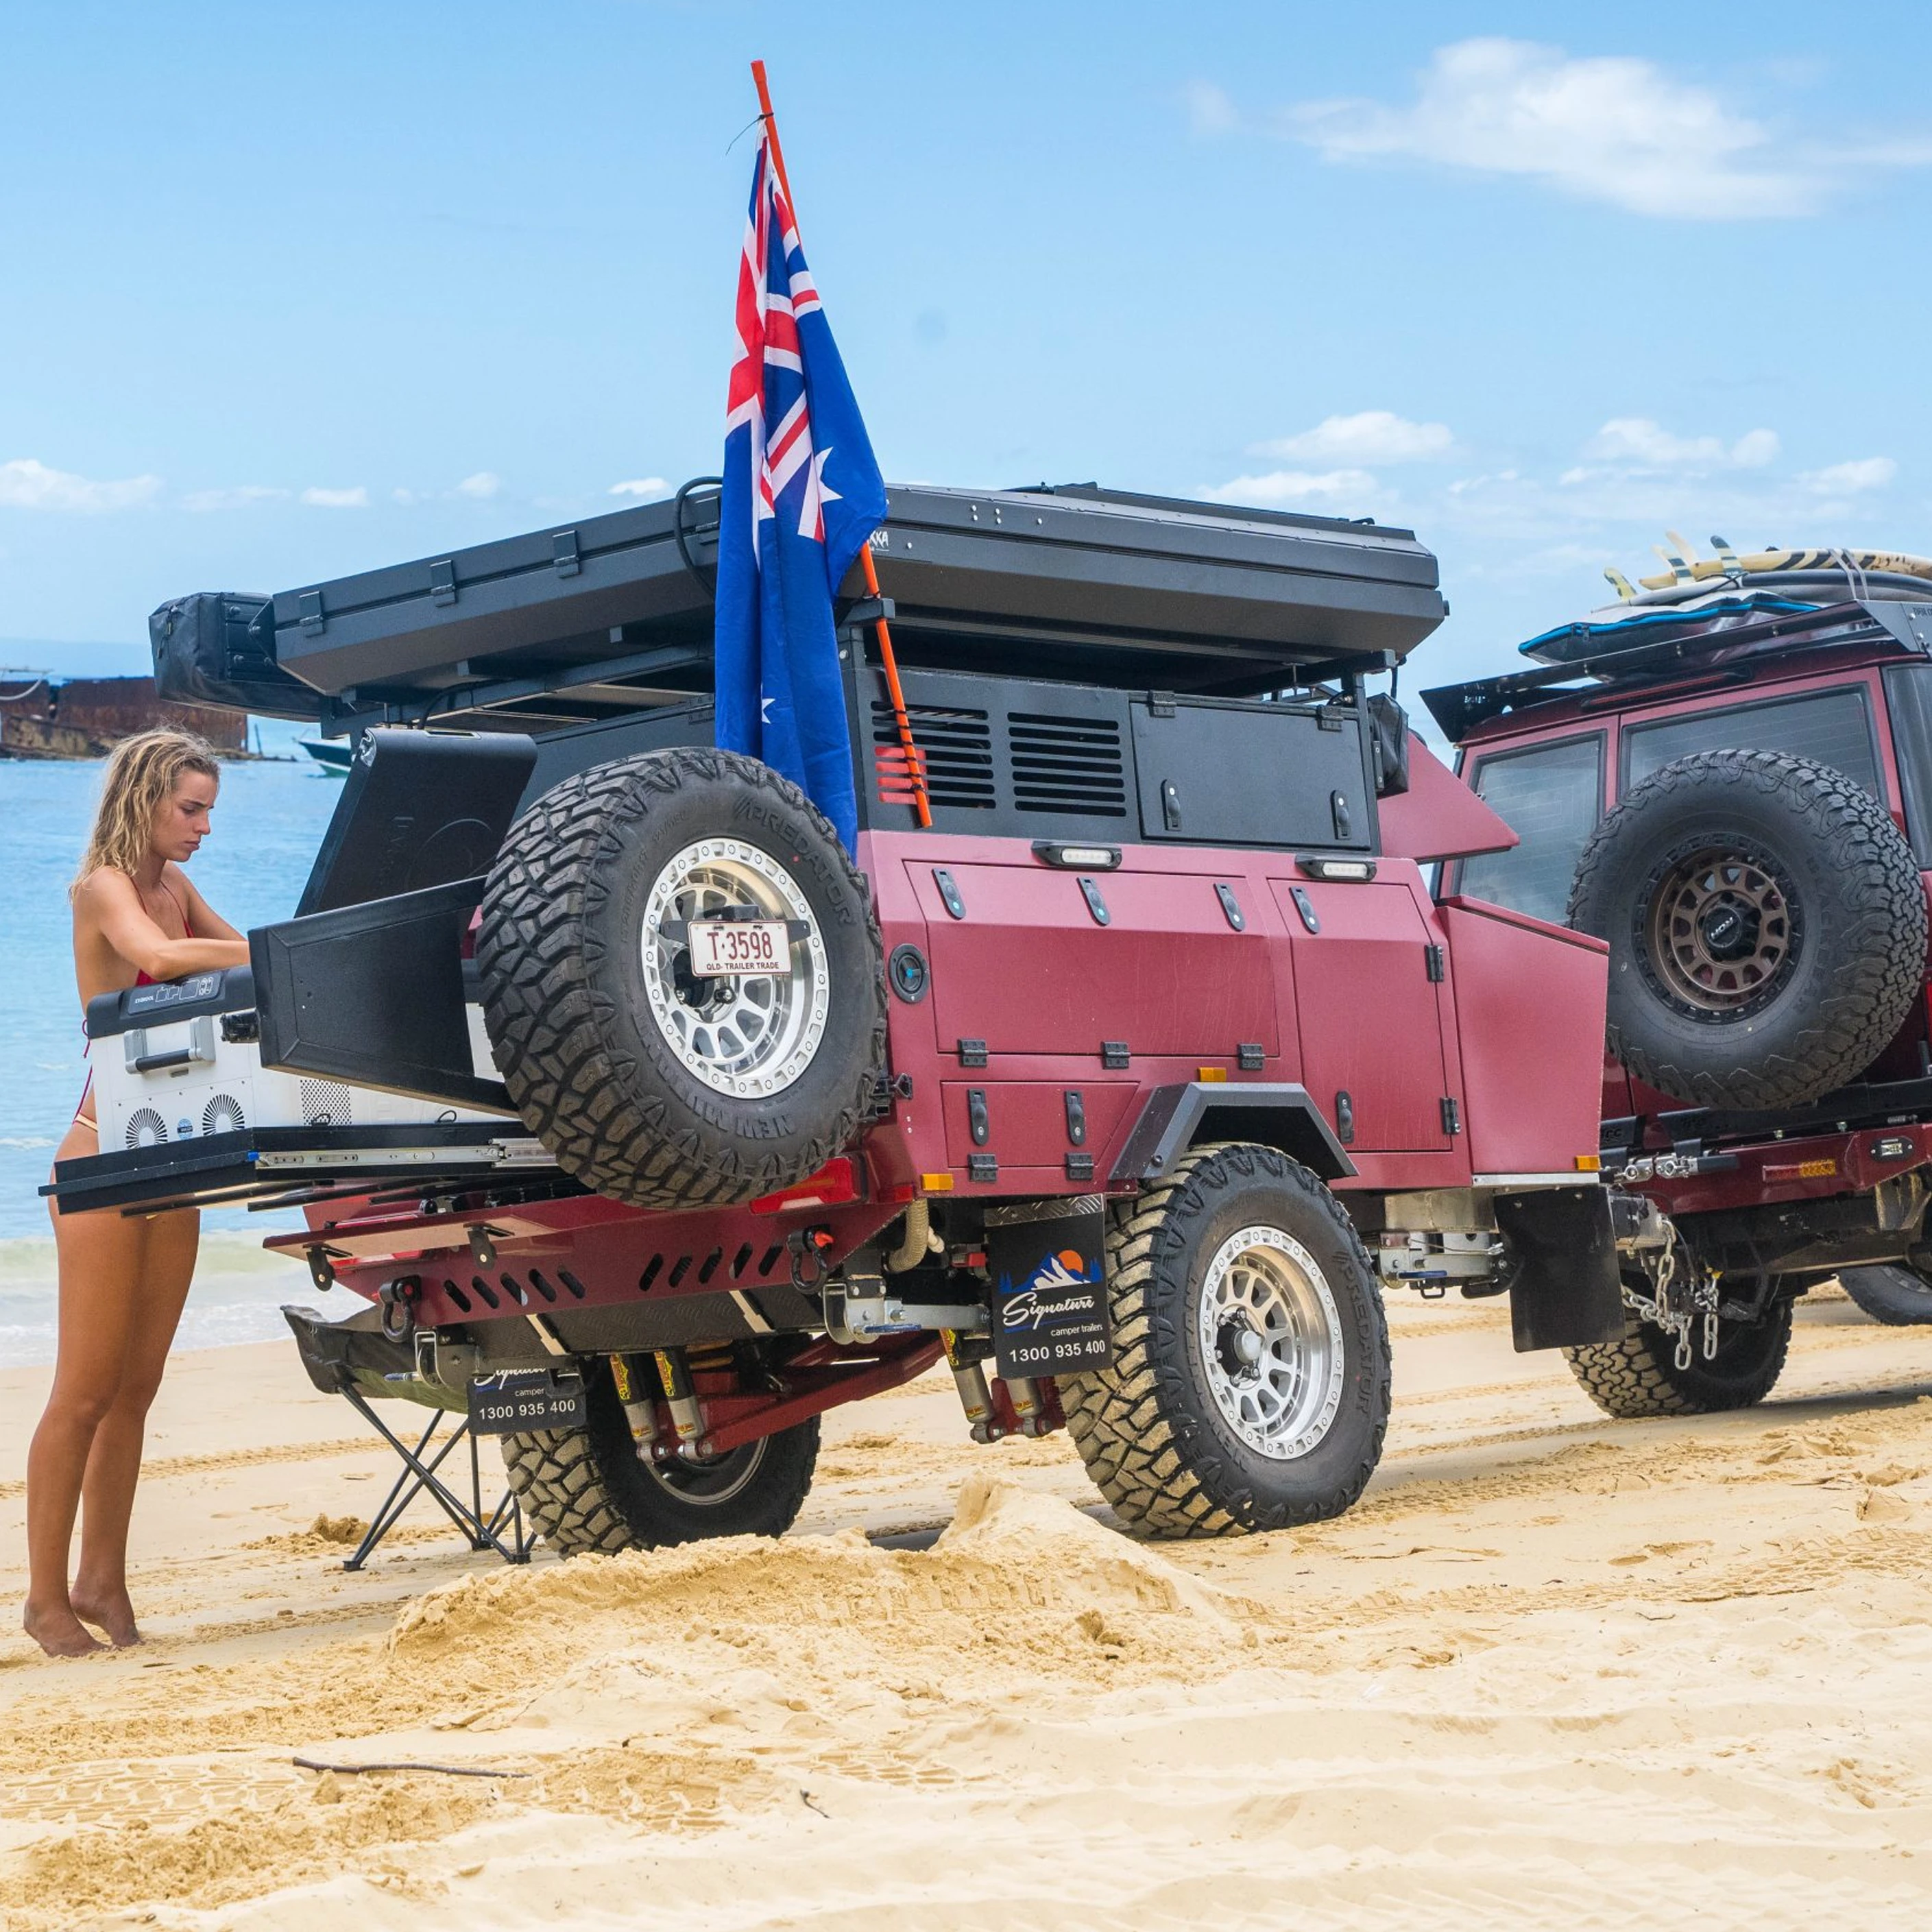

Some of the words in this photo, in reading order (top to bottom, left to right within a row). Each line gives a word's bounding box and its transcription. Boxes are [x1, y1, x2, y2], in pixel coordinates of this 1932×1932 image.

[756, 961, 779, 969] TRADE
[1002, 1292, 1095, 1330] Signature
[1050, 1327, 1080, 1338] camper
[1081, 1323, 1103, 1333] trailers
[1009, 1347, 1050, 1362] 1300
[1055, 1342, 1081, 1358] 935
[1085, 1340, 1106, 1355] 400
[515, 1387, 544, 1397] camper
[480, 1405, 513, 1420] 1300
[519, 1402, 544, 1416] 935
[550, 1399, 575, 1413] 400
